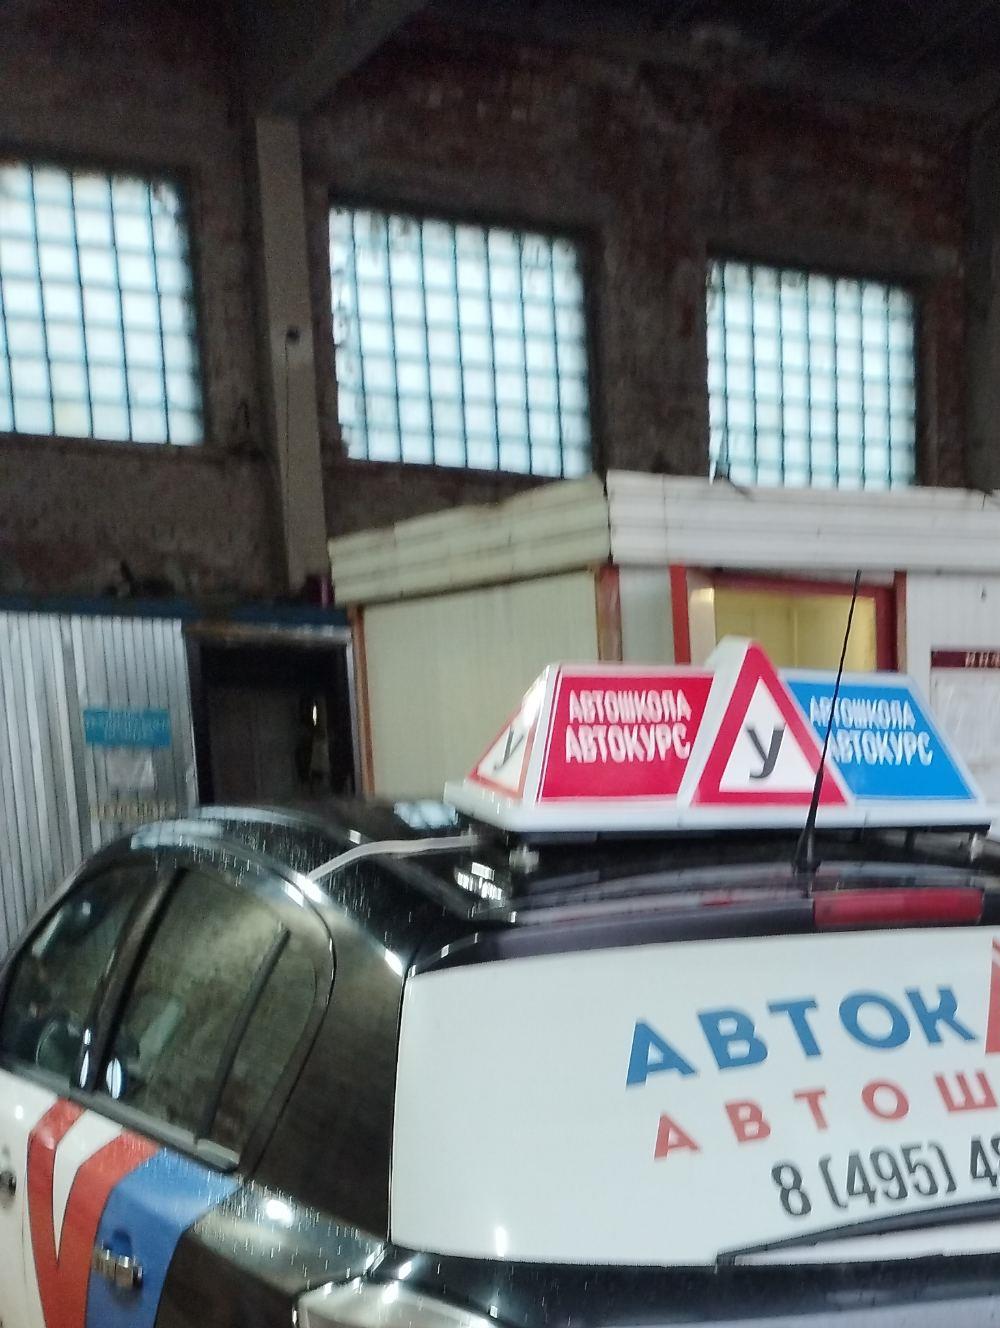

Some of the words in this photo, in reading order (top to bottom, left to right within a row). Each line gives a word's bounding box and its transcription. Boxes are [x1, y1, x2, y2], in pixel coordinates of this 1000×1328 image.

[569, 689, 692, 723] АВТОШКОЛА
[810, 696, 916, 730] АВТОШКОЛА
[566, 723, 691, 763] АВТОКУРС
[746, 724, 785, 779] У
[771, 1159, 812, 1218] 8
[819, 1140, 957, 1209] (495)
